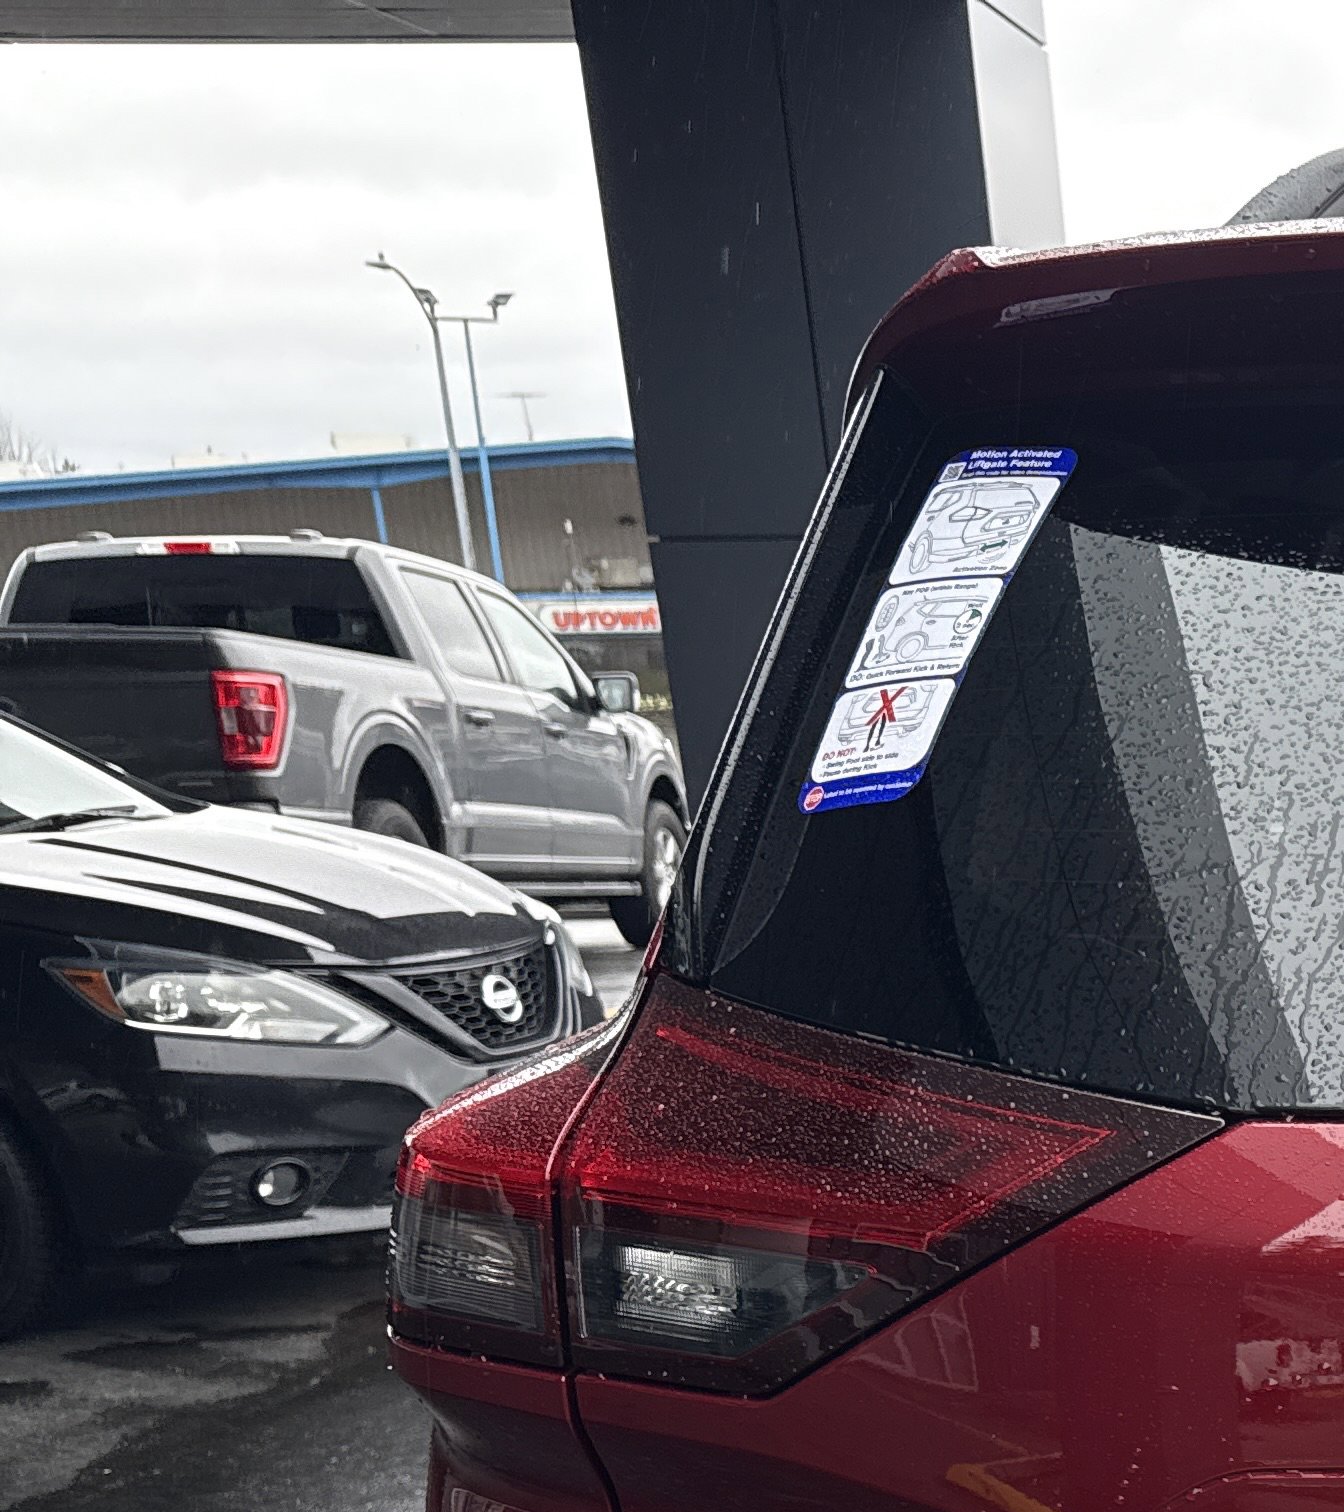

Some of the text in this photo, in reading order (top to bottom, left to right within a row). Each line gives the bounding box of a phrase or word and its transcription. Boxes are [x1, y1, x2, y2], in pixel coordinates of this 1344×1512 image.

[970, 450, 1062, 459] Motion Activated
[968, 460, 1052, 469] Liftgate Feature
[552, 608, 656, 631] UPTOWN
